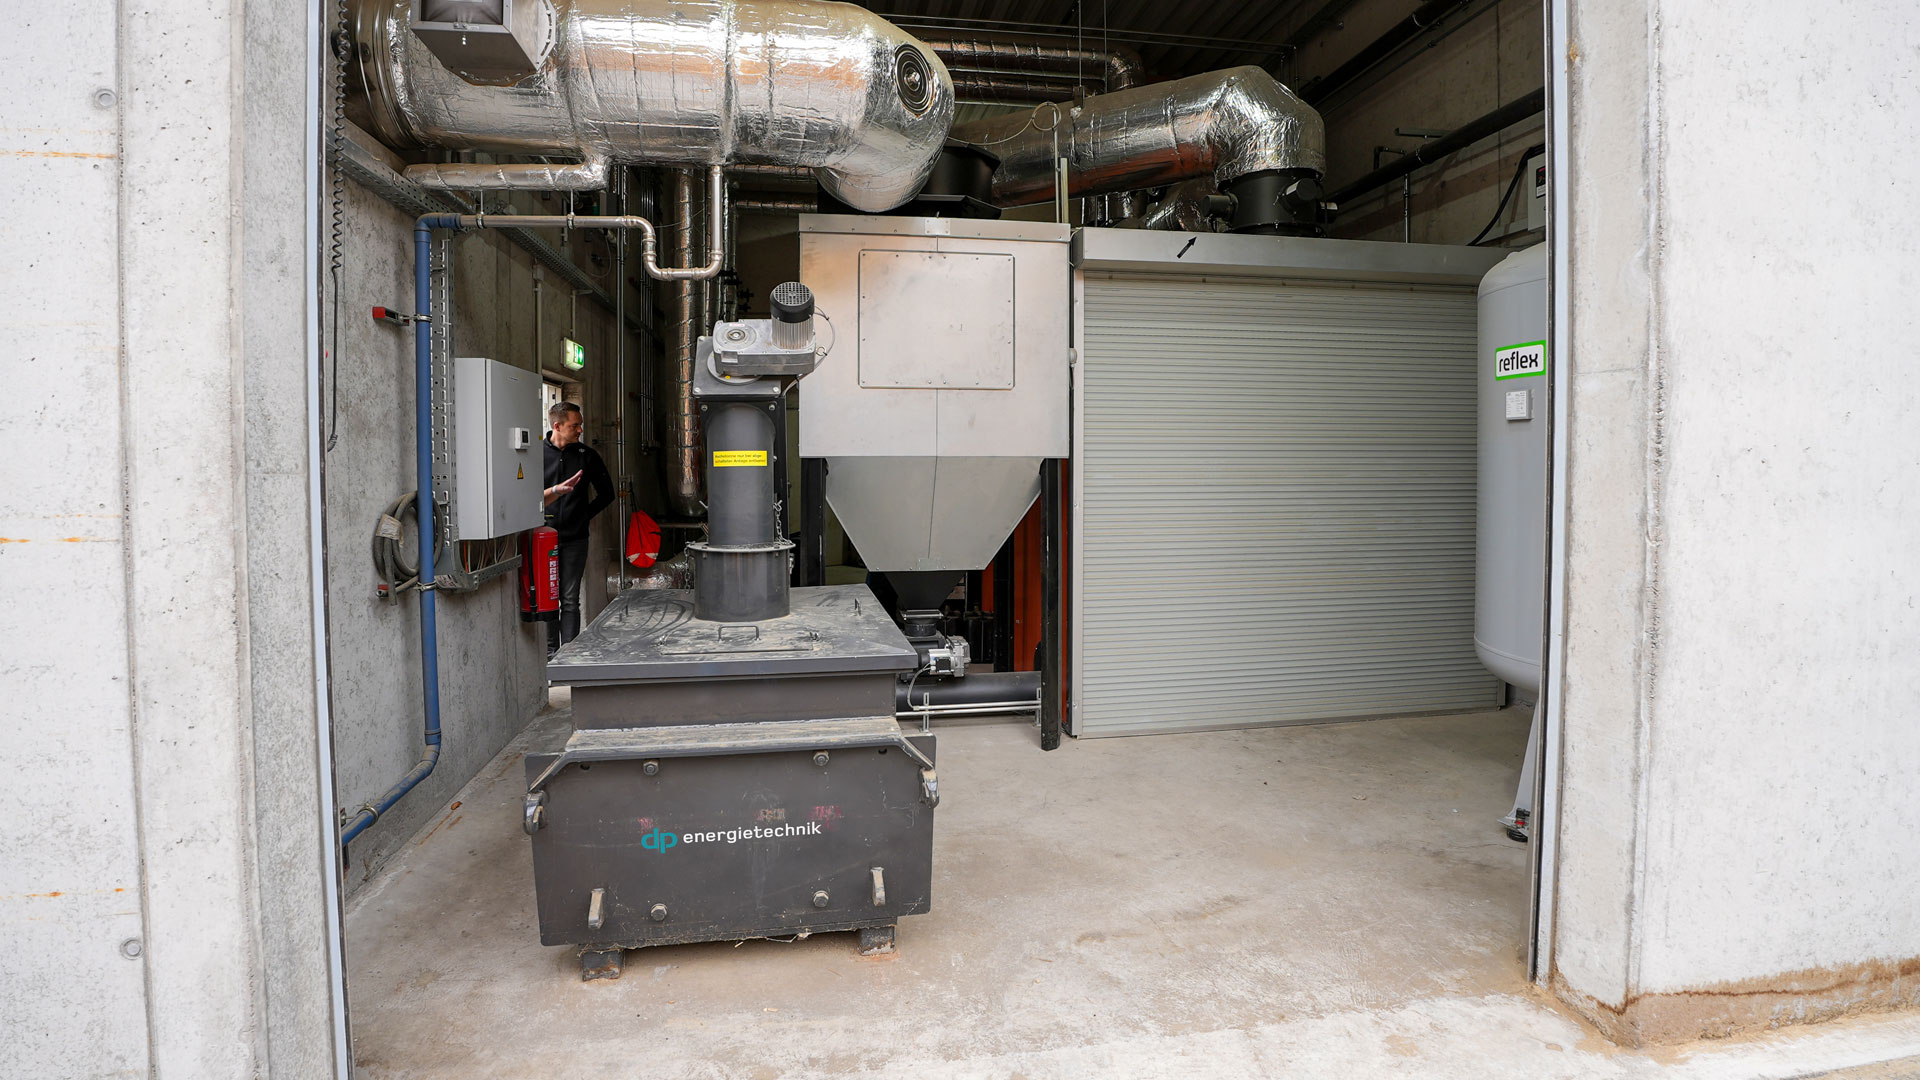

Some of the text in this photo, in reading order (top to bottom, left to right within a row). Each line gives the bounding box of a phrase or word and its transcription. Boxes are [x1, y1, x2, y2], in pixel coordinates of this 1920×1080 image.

[1499, 351, 1538, 372] reflex
[641, 821, 821, 854] dp energietechnik
